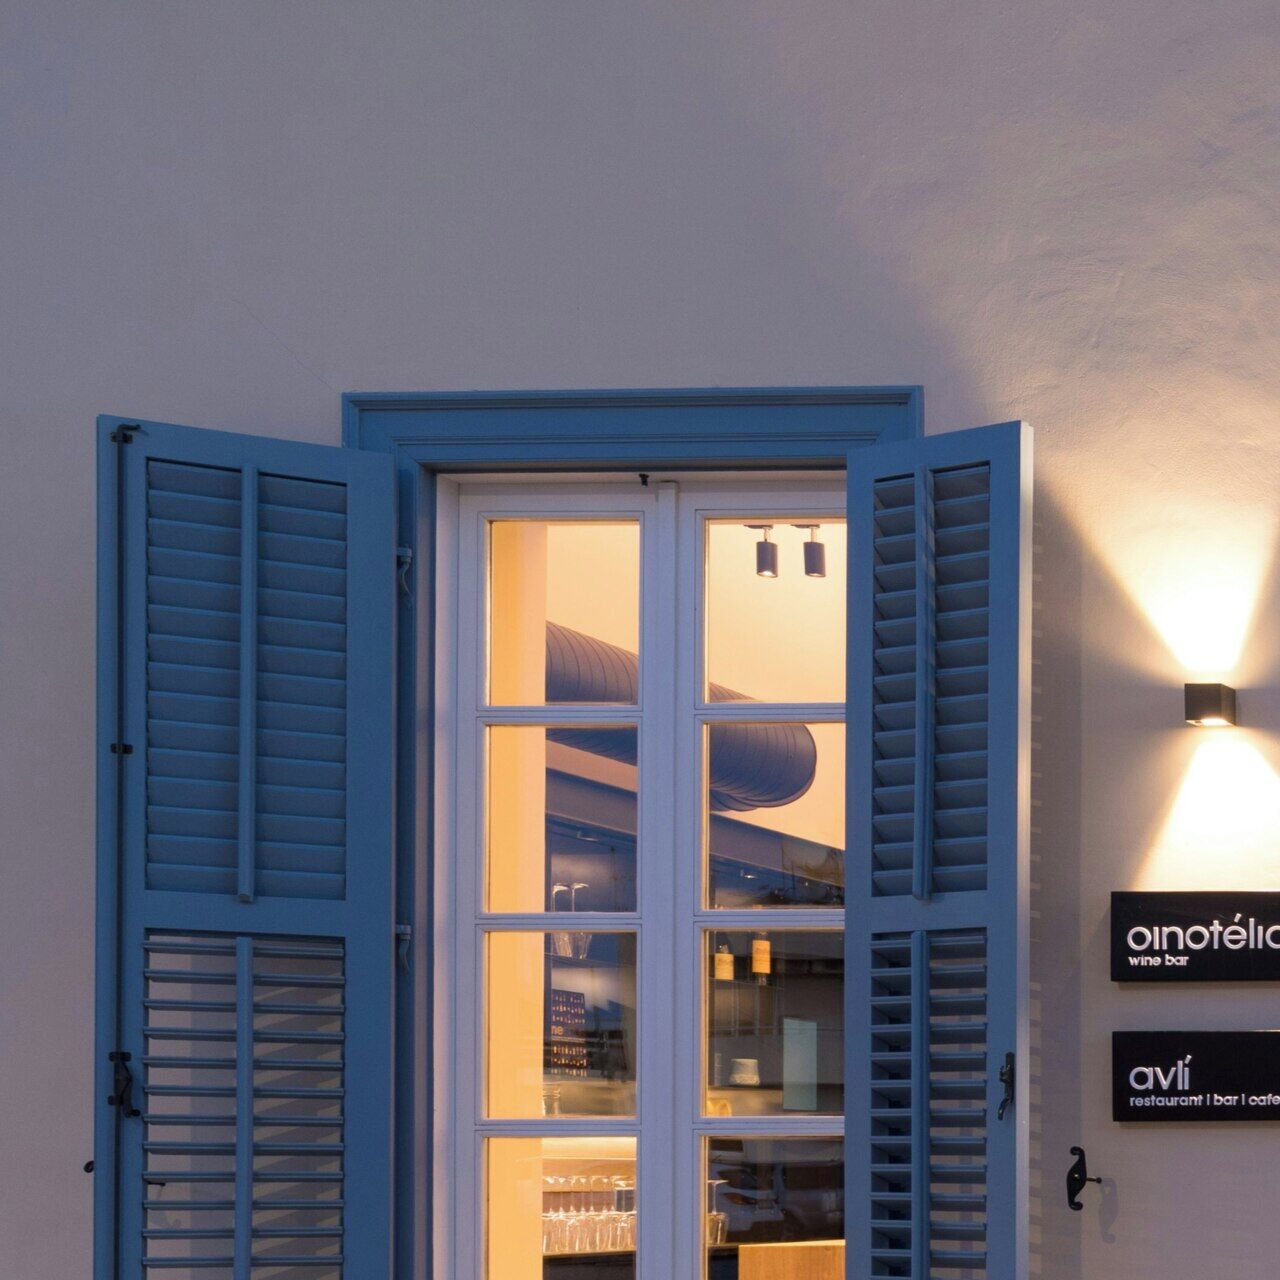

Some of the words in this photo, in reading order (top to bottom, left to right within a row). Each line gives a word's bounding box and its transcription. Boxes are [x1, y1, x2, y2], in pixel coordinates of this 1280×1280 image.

[1128, 954, 1161, 966] wine
[1164, 953, 1190, 966] bar
[1129, 1054, 1192, 1091] avlí
[1129, 1094, 1204, 1107] restaurant
[1213, 1093, 1239, 1106] bar
